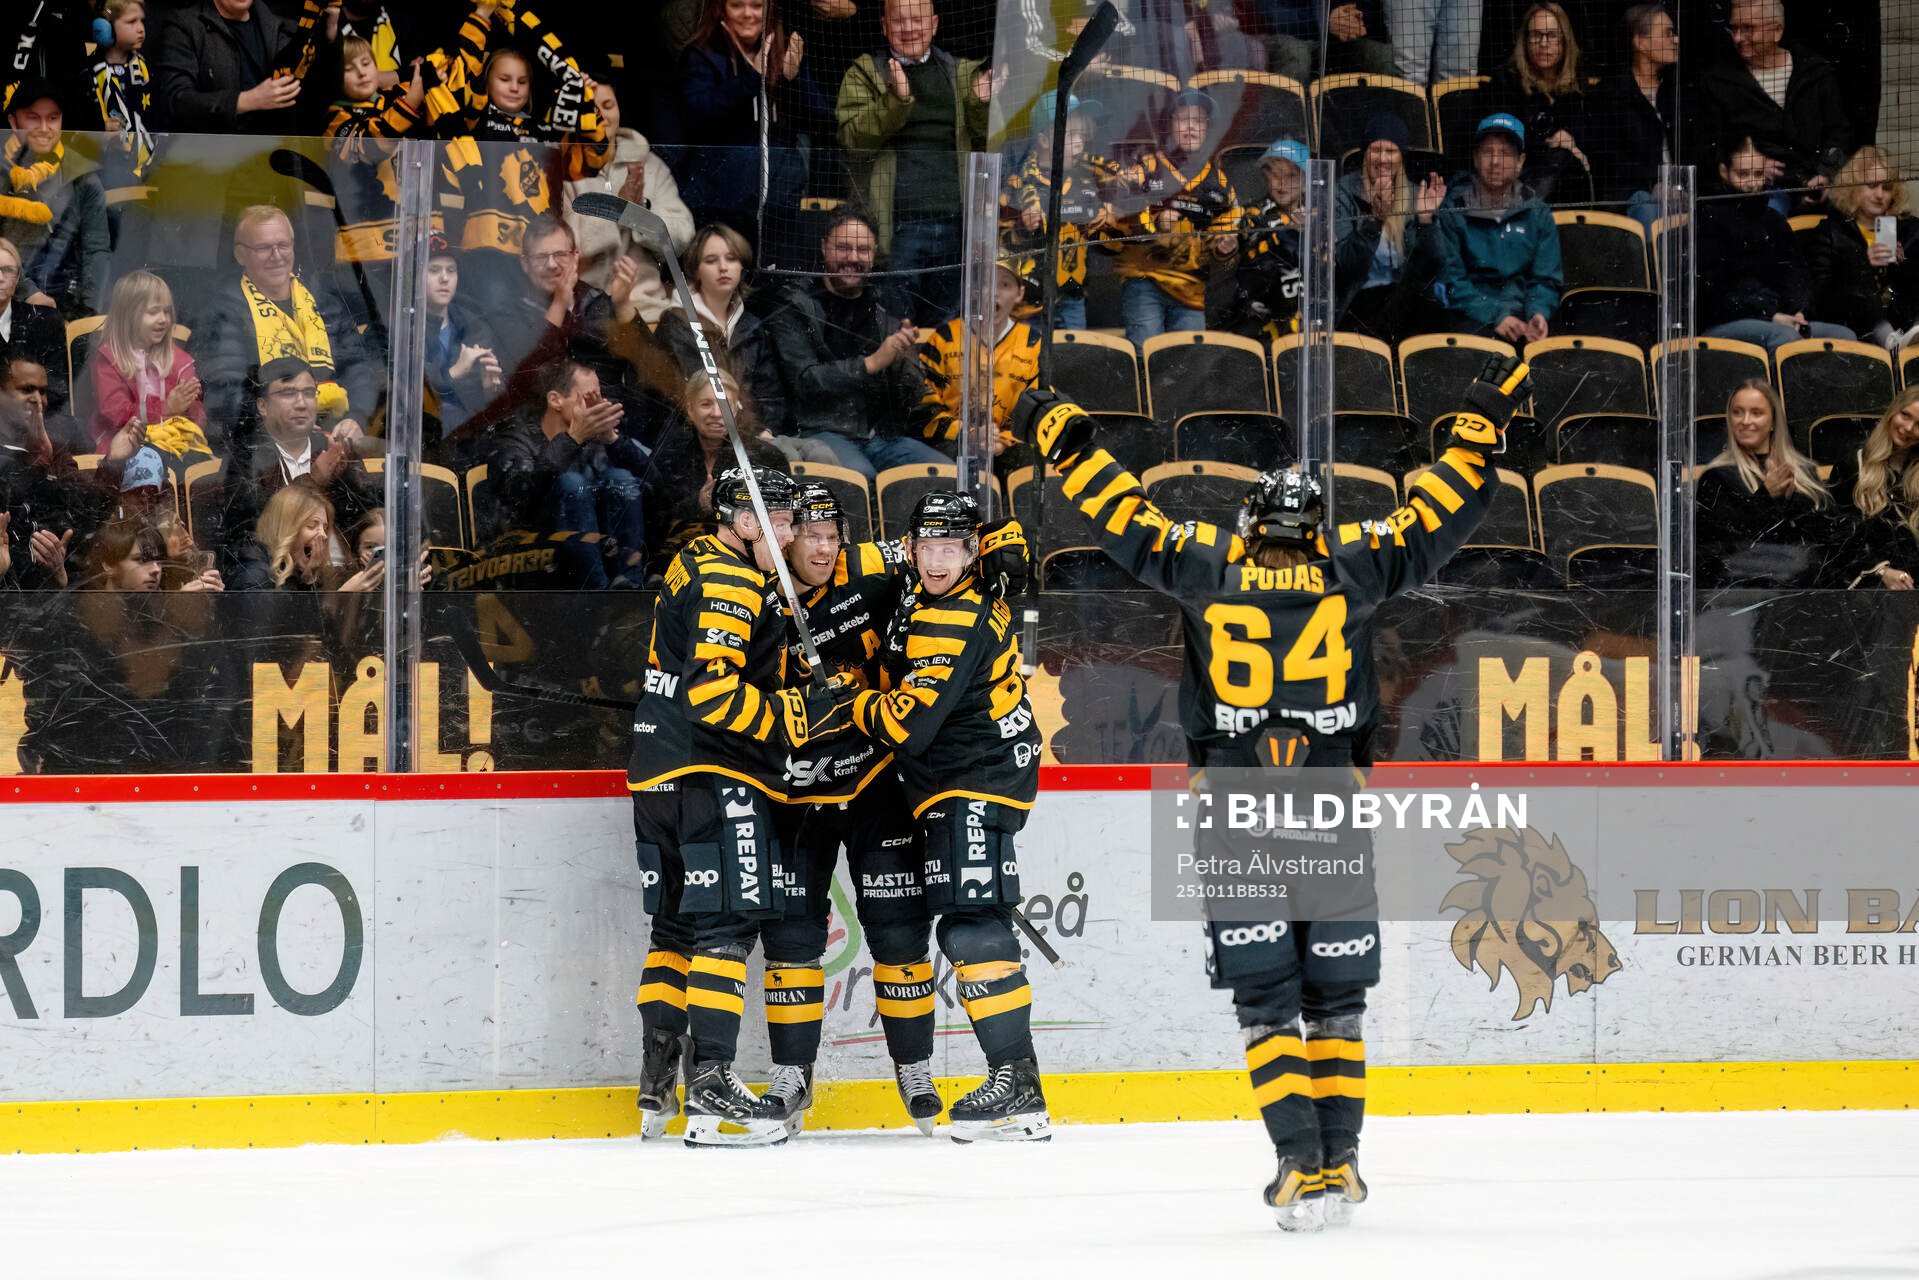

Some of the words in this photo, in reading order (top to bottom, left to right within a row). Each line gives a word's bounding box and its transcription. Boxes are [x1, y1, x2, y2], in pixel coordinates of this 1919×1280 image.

[689, 321, 727, 400] CCM
[811, 502, 833, 510] CCM
[1240, 564, 1325, 594] PUDAS
[710, 600, 753, 622] HOLMEN
[829, 592, 862, 615] engcon
[838, 611, 871, 634] skebo
[860, 628, 881, 661] A
[1203, 595, 1353, 706] 64
[706, 657, 727, 677] 4
[252, 655, 495, 774] MÅL!
[1478, 650, 1701, 762] MÅL!
[834, 765, 858, 777] Kraft
[881, 837, 913, 847] CCM
[735, 821, 761, 905] REPAY
[862, 871, 915, 887] BASTU
[863, 886, 923, 898] PRODUKTER
[1633, 888, 1822, 935] LION
[1219, 920, 1288, 947] coop
[1311, 933, 1377, 959] coop
[1676, 946, 1803, 967] GERMAN
[1813, 945, 1889, 966] BEER
[883, 981, 933, 999] NORRAN
[1005, 1085, 1036, 1115] CCM
